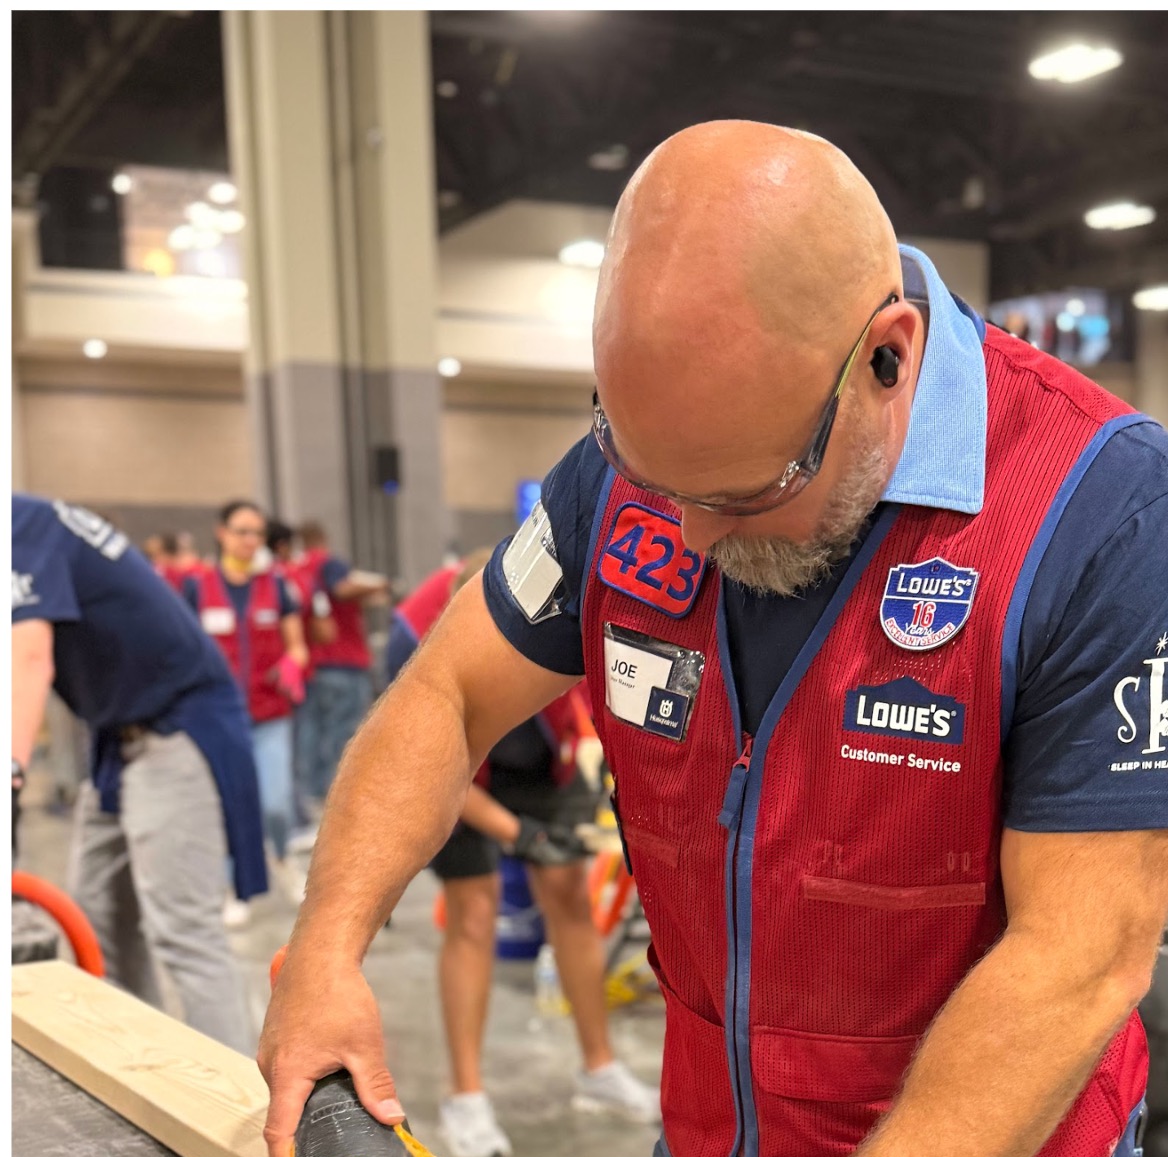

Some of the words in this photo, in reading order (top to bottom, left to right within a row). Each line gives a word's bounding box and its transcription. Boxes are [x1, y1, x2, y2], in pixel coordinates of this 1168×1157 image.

[606, 524, 701, 602] 423
[896, 572, 965, 597] LOWE'S
[912, 600, 937, 629] 16
[904, 622, 935, 636] Years
[920, 622, 956, 646] SERVICE
[611, 659, 638, 679] JOE
[856, 694, 952, 738] LOWE'S
[841, 744, 905, 766] Customer
[907, 753, 962, 773] Service
[1110, 761, 1140, 772] SLEEP
[1141, 760, 1153, 770] IN
